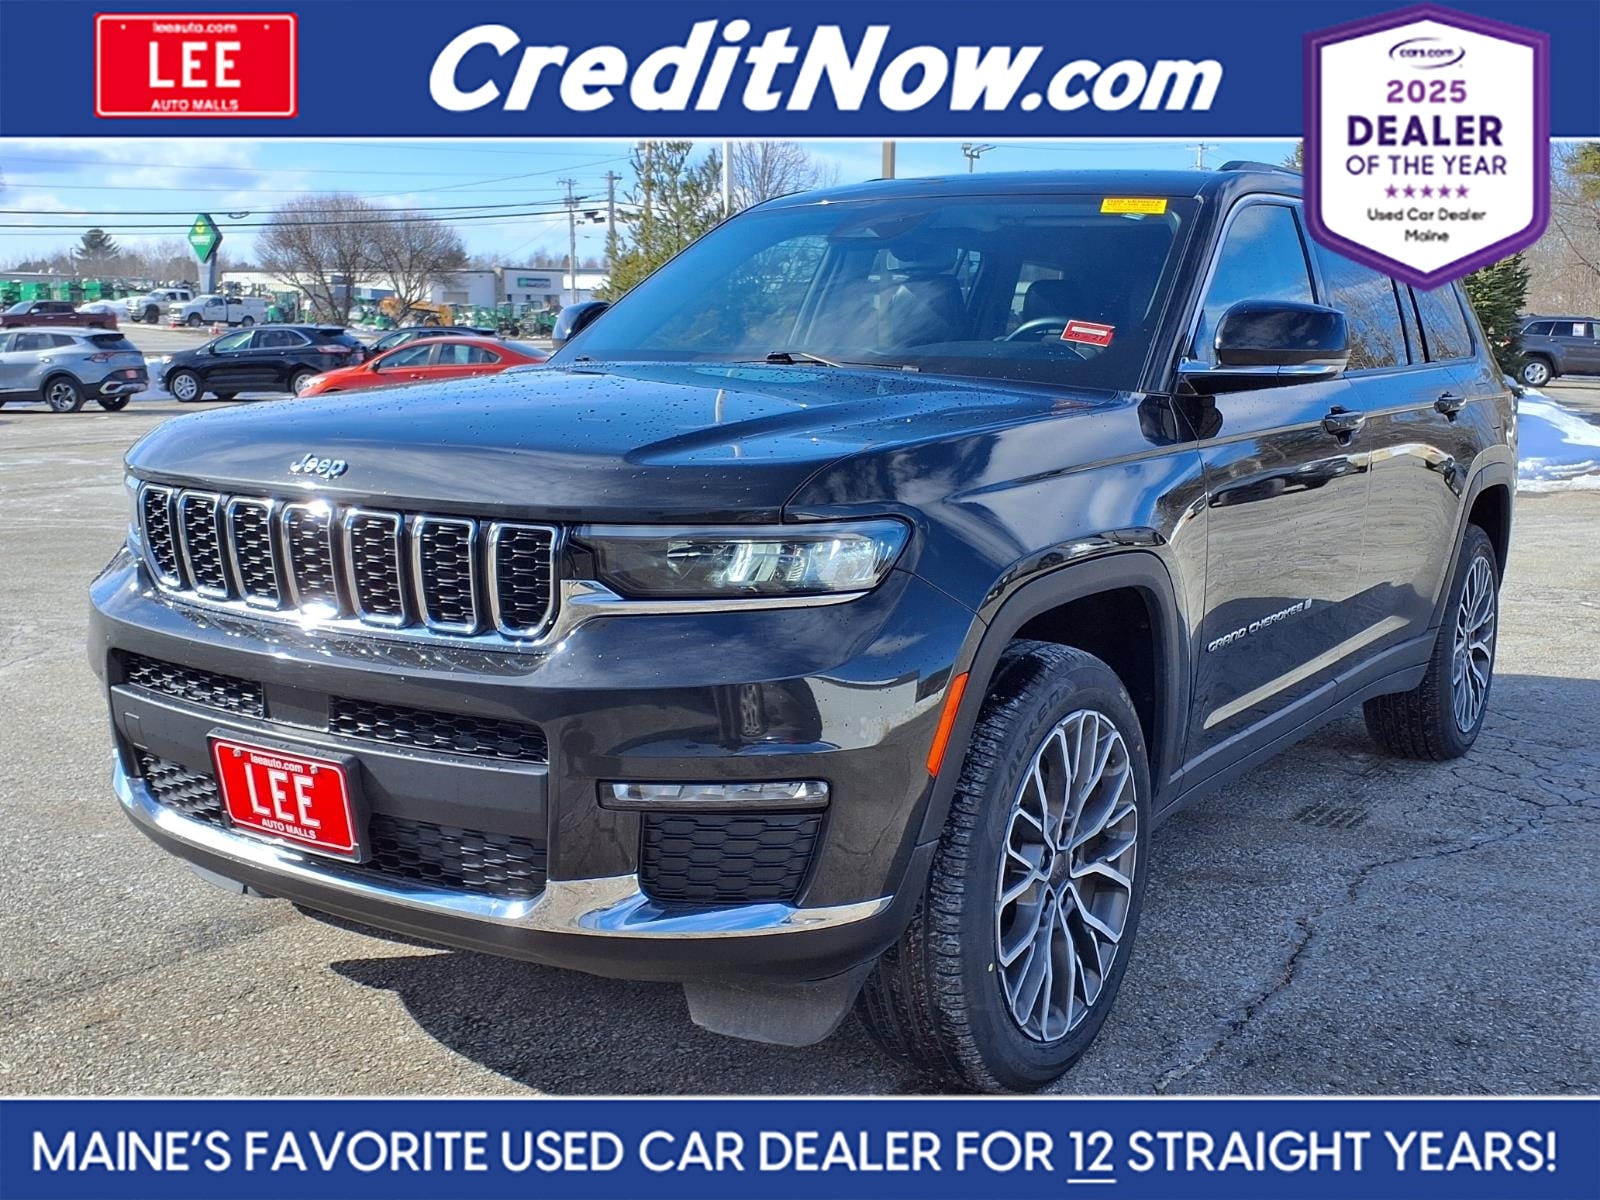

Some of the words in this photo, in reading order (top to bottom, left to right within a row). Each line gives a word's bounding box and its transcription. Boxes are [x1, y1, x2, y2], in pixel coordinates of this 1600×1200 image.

[289, 452, 346, 479] Jeep
[1207, 627, 1247, 653] GRAND
[1249, 602, 1304, 633] CHEROKEE
[250, 753, 304, 774] leeauto.com
[244, 762, 321, 827] LEE
[261, 818, 285, 832] AUTO
[286, 825, 317, 840] MALLS
